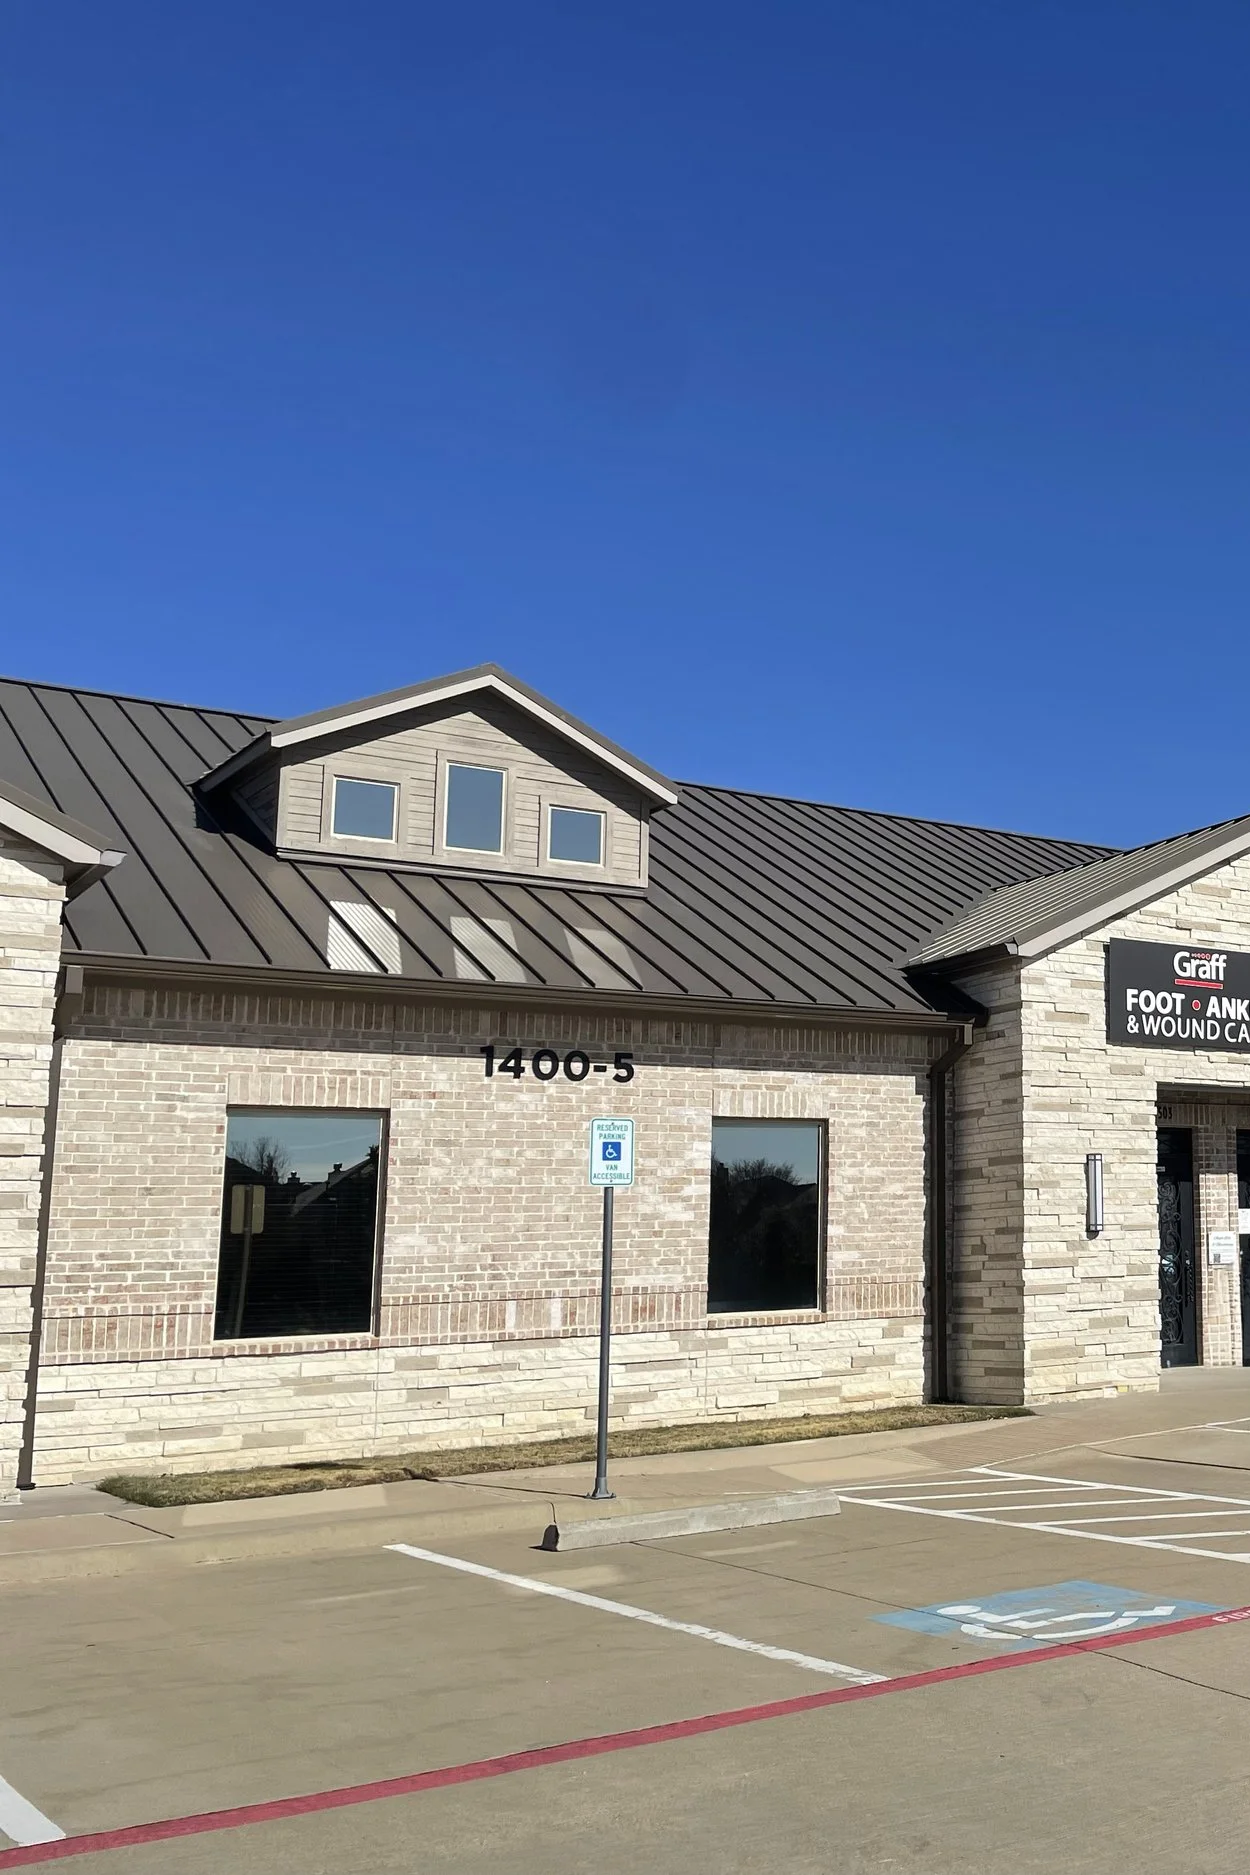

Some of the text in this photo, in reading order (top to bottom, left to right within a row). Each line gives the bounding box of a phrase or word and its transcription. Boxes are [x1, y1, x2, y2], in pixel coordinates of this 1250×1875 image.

[1173, 951, 1227, 981] Graff
[1126, 988, 1186, 1016] FOOT
[1126, 1014, 1140, 1034] &
[1141, 1013, 1221, 1041] WOUND
[480, 1045, 635, 1083] 1400-5
[1158, 1106, 1173, 1120] 503
[596, 1124, 629, 1132] RESERVED
[598, 1132, 626, 1140] PARKING
[592, 1172, 631, 1180] ACCESSIBLE
